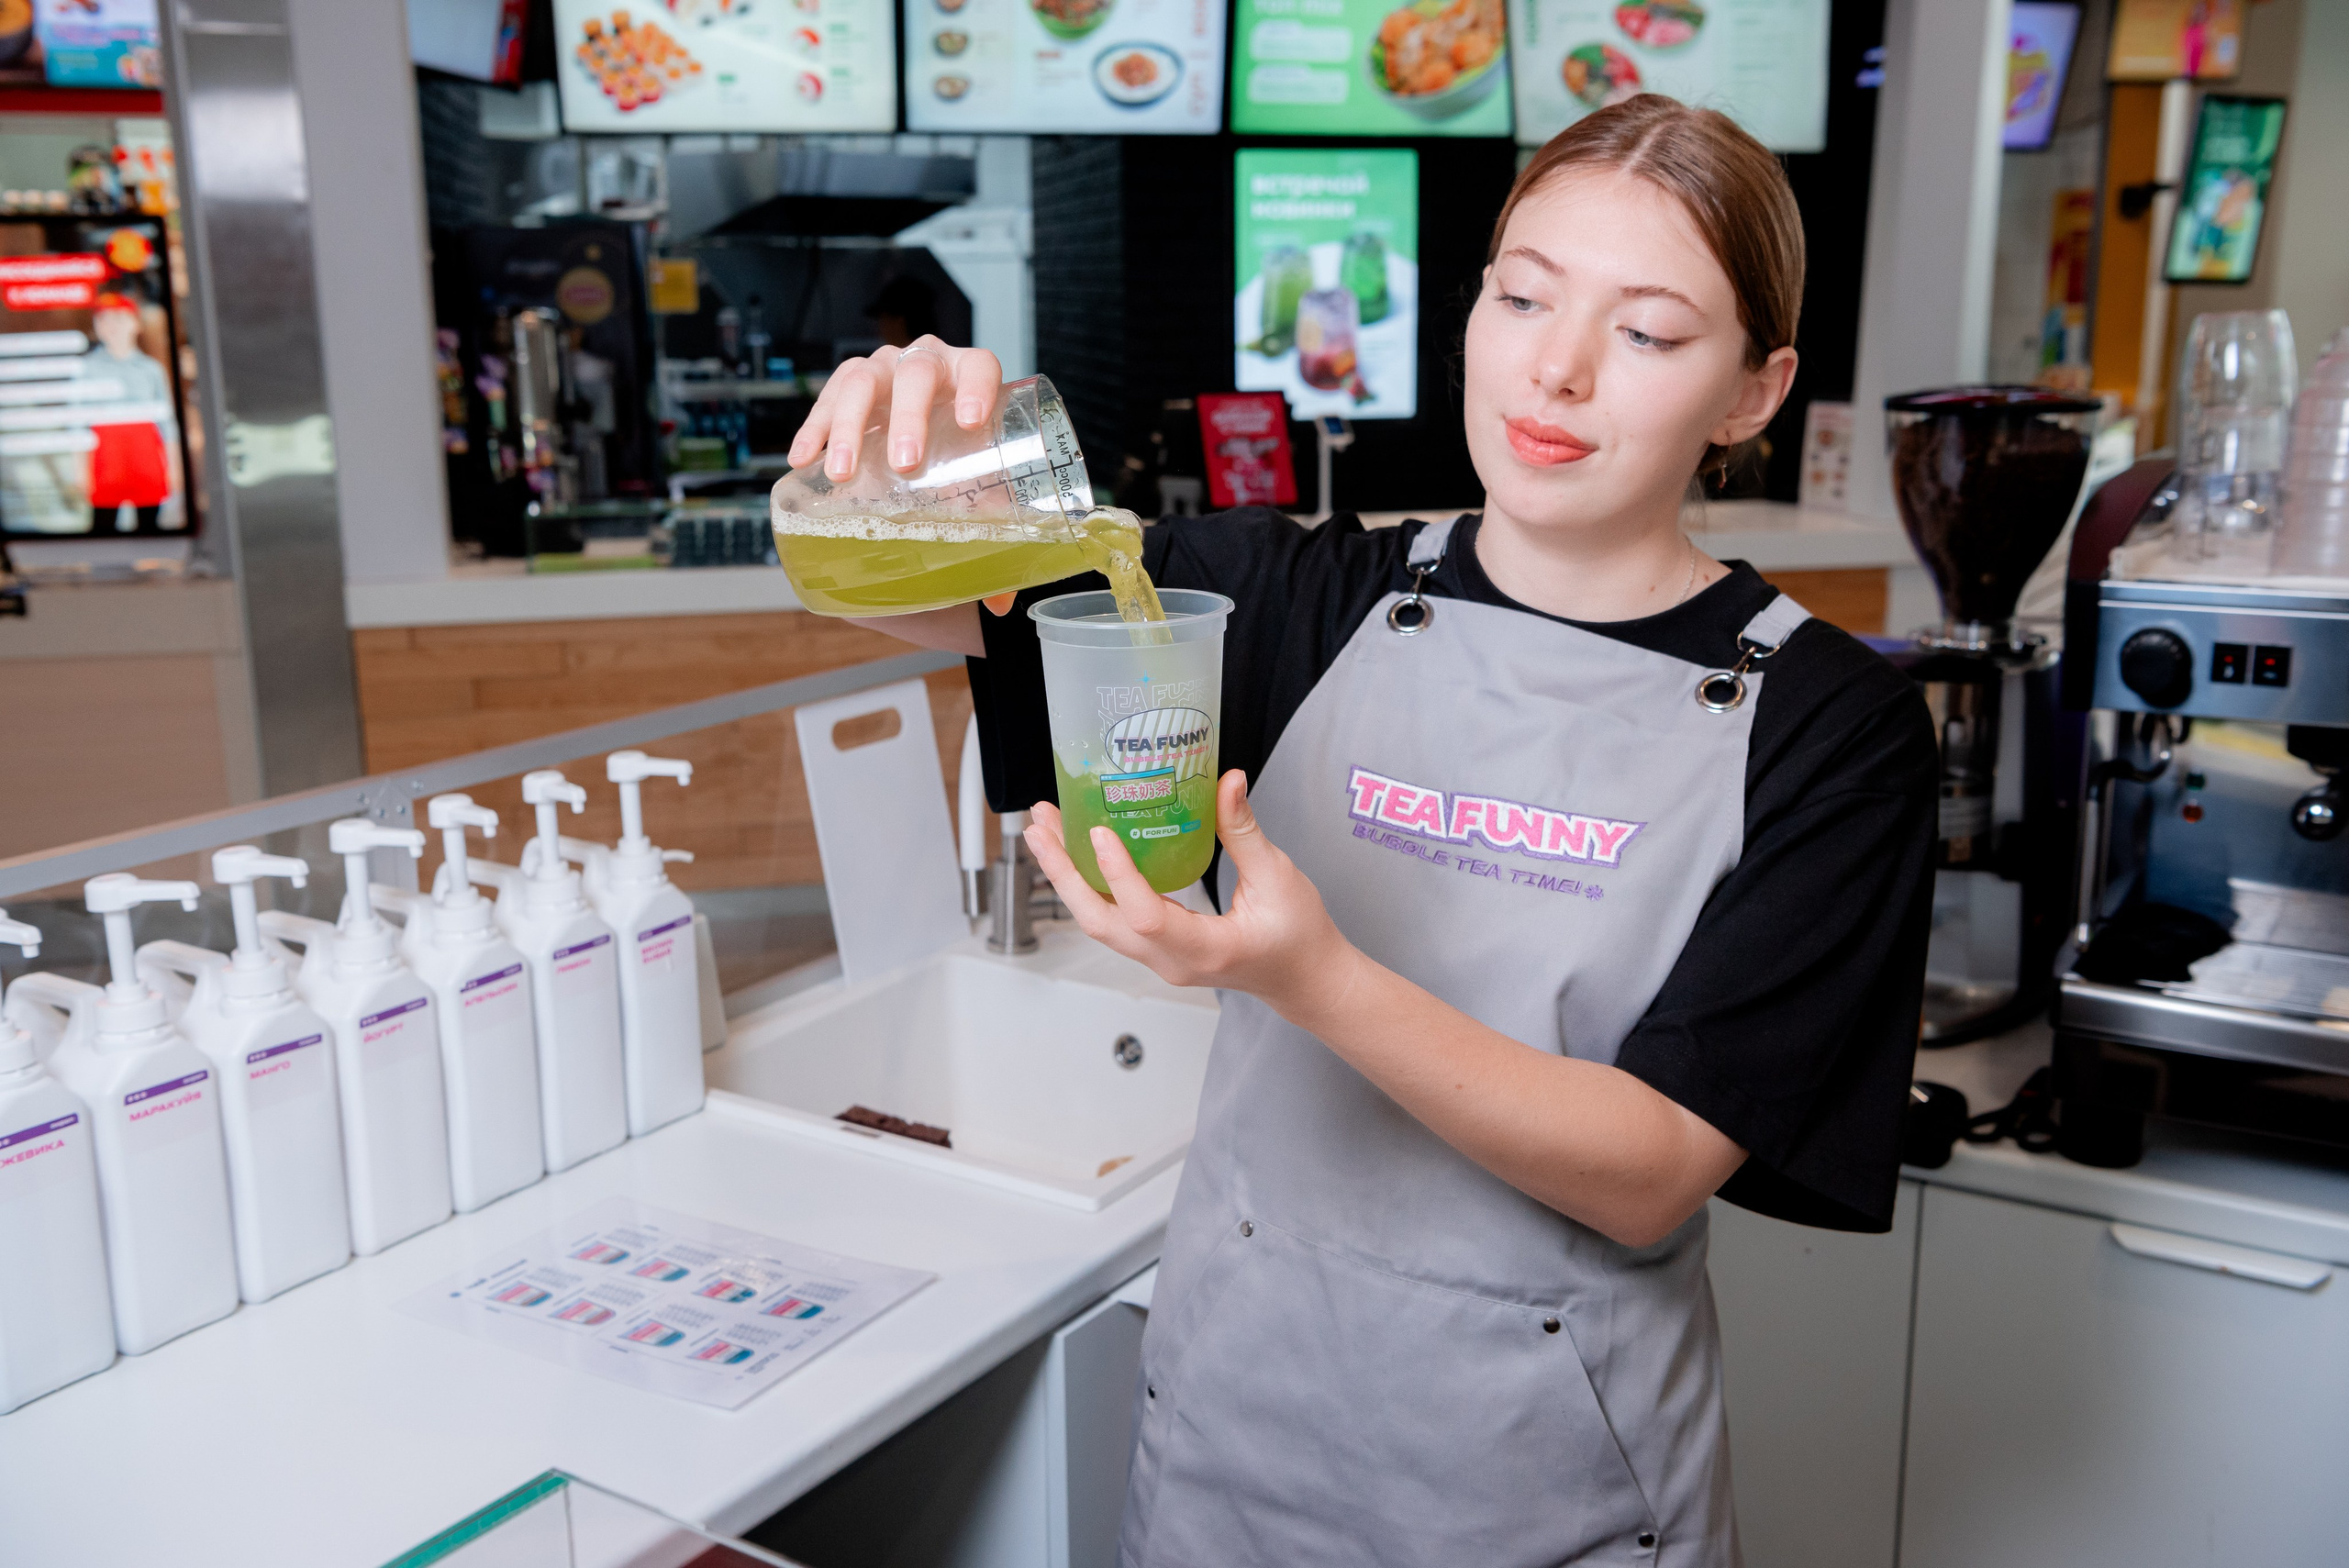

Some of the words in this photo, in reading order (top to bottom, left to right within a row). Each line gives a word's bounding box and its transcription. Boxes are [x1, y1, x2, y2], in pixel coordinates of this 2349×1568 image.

[1097, 686, 1148, 715] TEA
[1114, 737, 1153, 752] TEA
[1157, 728, 1209, 750] FUNNY
[1123, 754, 1163, 763] BUBBLE
[1165, 751, 1184, 760] TEA
[1105, 778, 1172, 804] 珍珠奶茶
[1351, 770, 1447, 838] TEA
[1449, 795, 1639, 862] FUNNY
[1353, 823, 1452, 866] BUBBLE
[1455, 855, 1502, 881] TEA
[1509, 869, 1582, 896] TIME!
[363, 1022, 403, 1043] ЙОГУРТ
[250, 1061, 291, 1080] МАНГО
[129, 1091, 202, 1121] МАРАКУЙЯ
